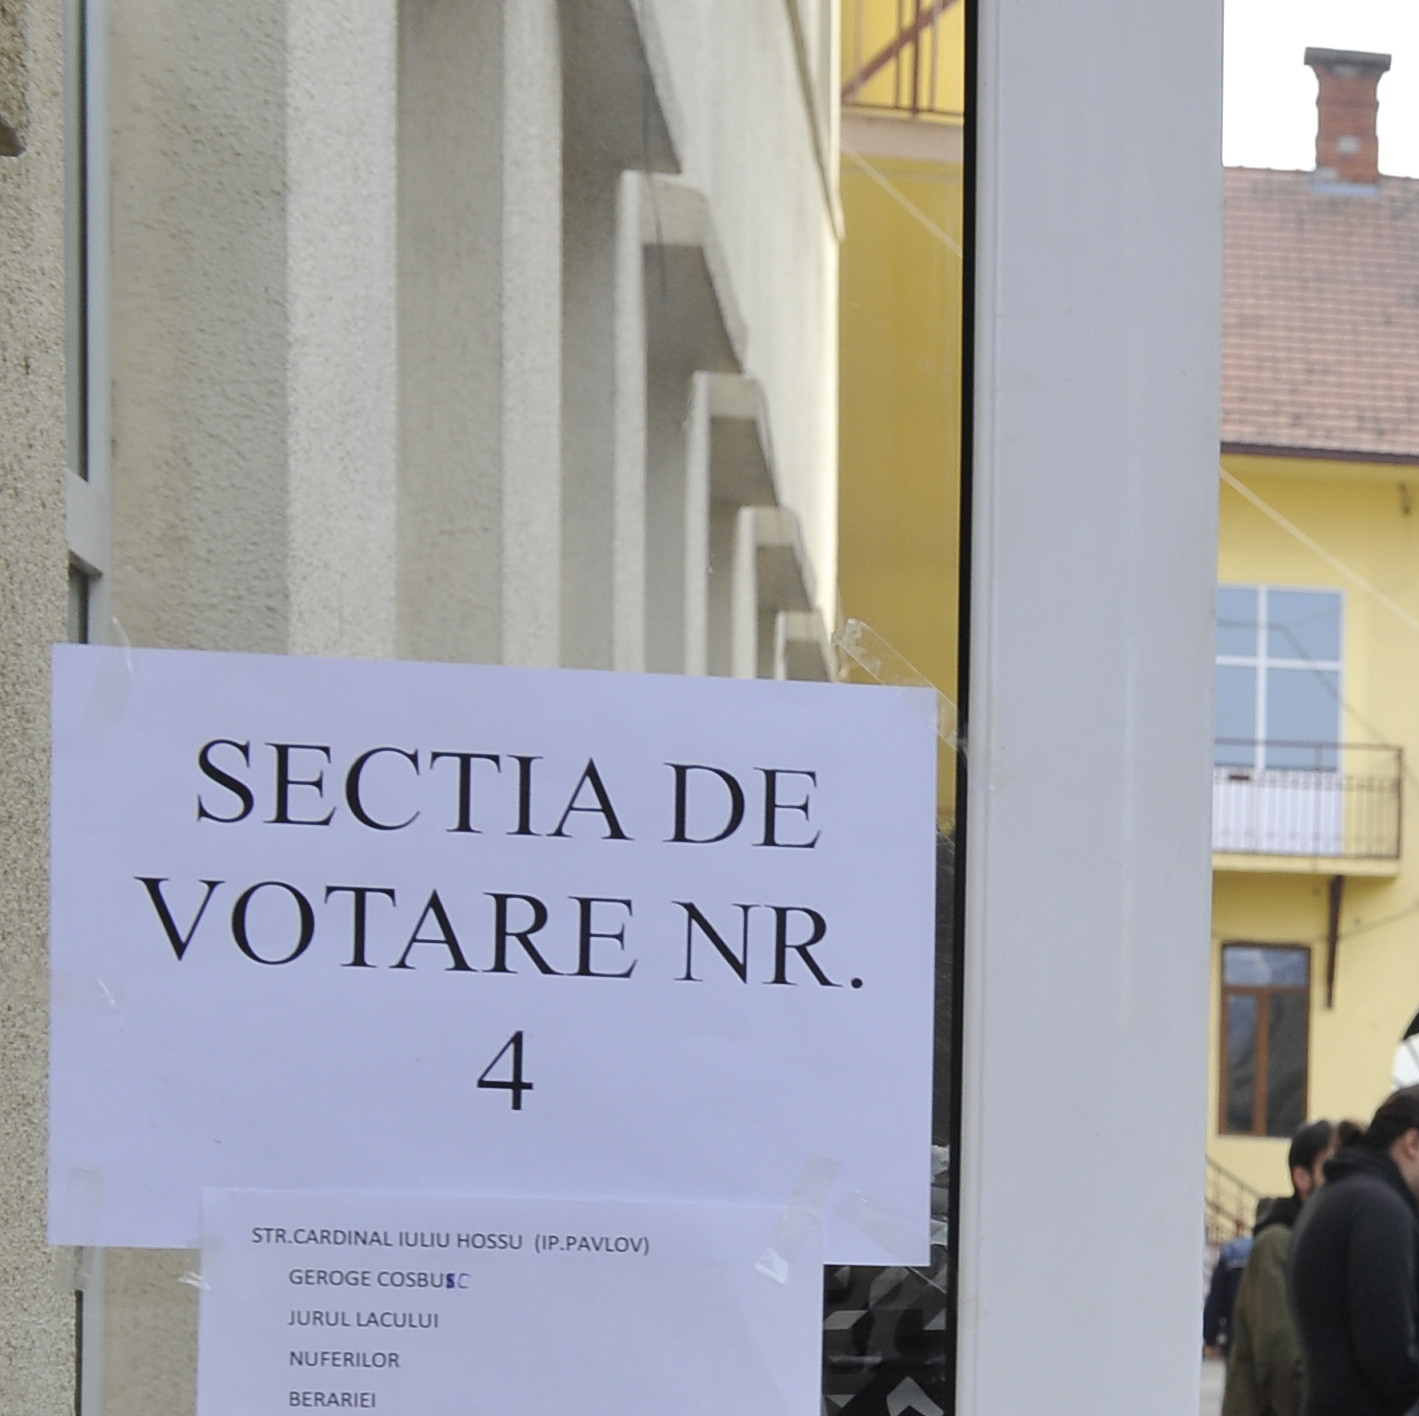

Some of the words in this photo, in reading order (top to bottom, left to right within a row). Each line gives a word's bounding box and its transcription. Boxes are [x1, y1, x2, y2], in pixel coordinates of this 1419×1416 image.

[197, 738, 634, 841] SECTIA
[664, 762, 820, 849] DE
[134, 876, 637, 979] VOTARE
[672, 900, 863, 989] NR.
[476, 1030, 534, 1111] 4
[251, 1227, 393, 1247] STR.CARDINAL
[398, 1231, 450, 1249] IULIU
[457, 1233, 523, 1250] HOSSU
[534, 1233, 650, 1257] (IP.PAVLOV)
[288, 1268, 372, 1287] GEROGE
[287, 1310, 352, 1327] JURUL
[356, 1311, 439, 1329] LACULUI
[289, 1350, 400, 1368] NUFERILOR
[289, 1391, 376, 1409] BERARIEI
